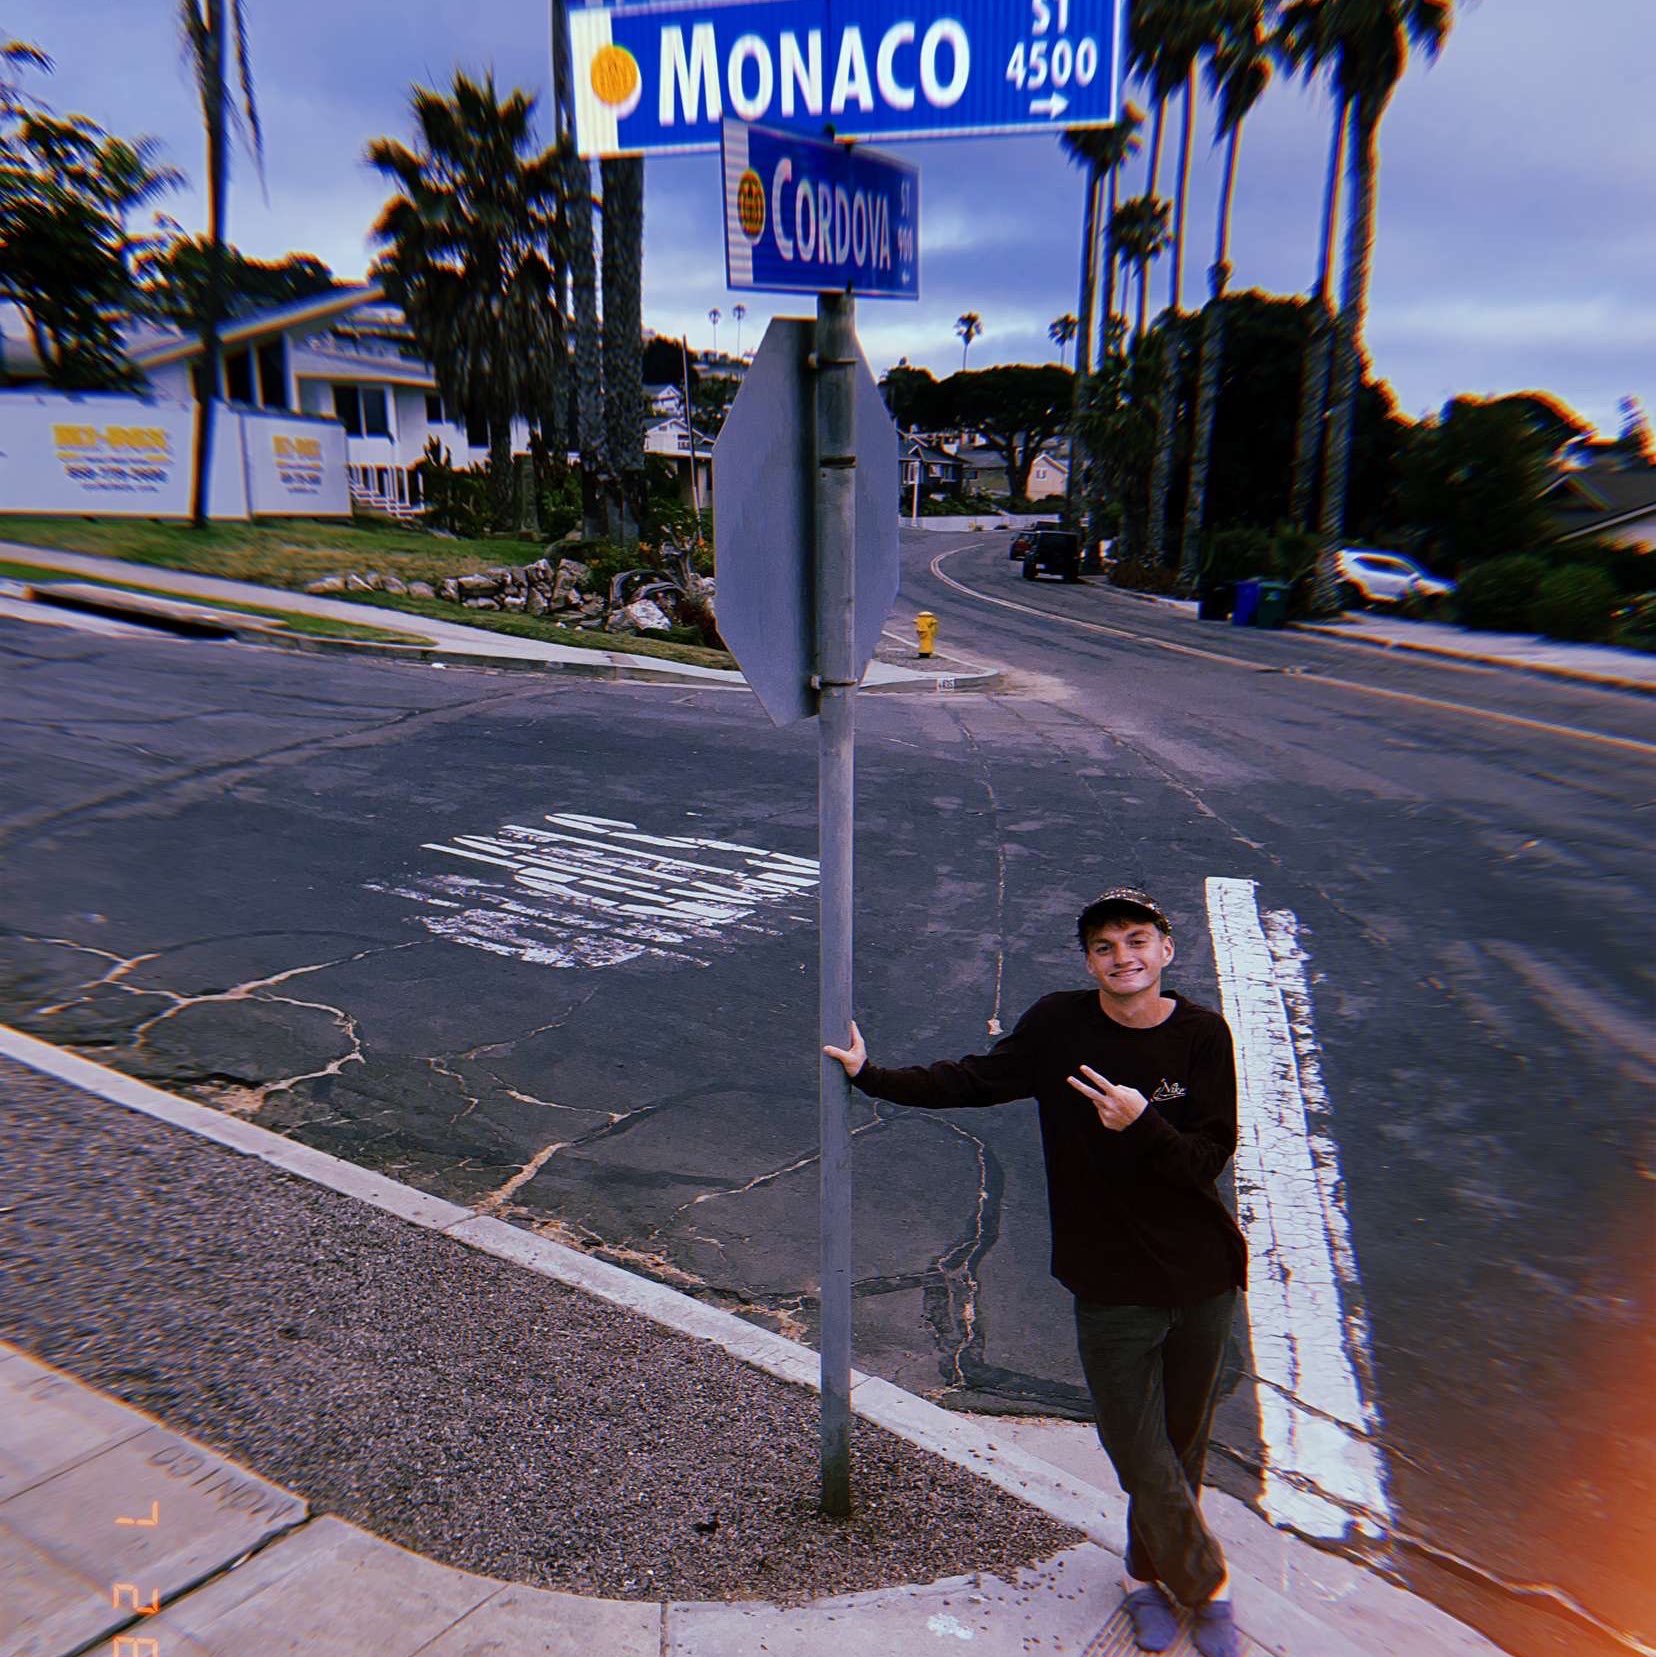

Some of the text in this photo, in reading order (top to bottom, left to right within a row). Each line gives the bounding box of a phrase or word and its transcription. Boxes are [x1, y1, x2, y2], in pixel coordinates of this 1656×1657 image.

[658, 18, 970, 127] MONACO
[1005, 36, 1098, 91] 4500
[772, 157, 891, 271] CORDOVA
